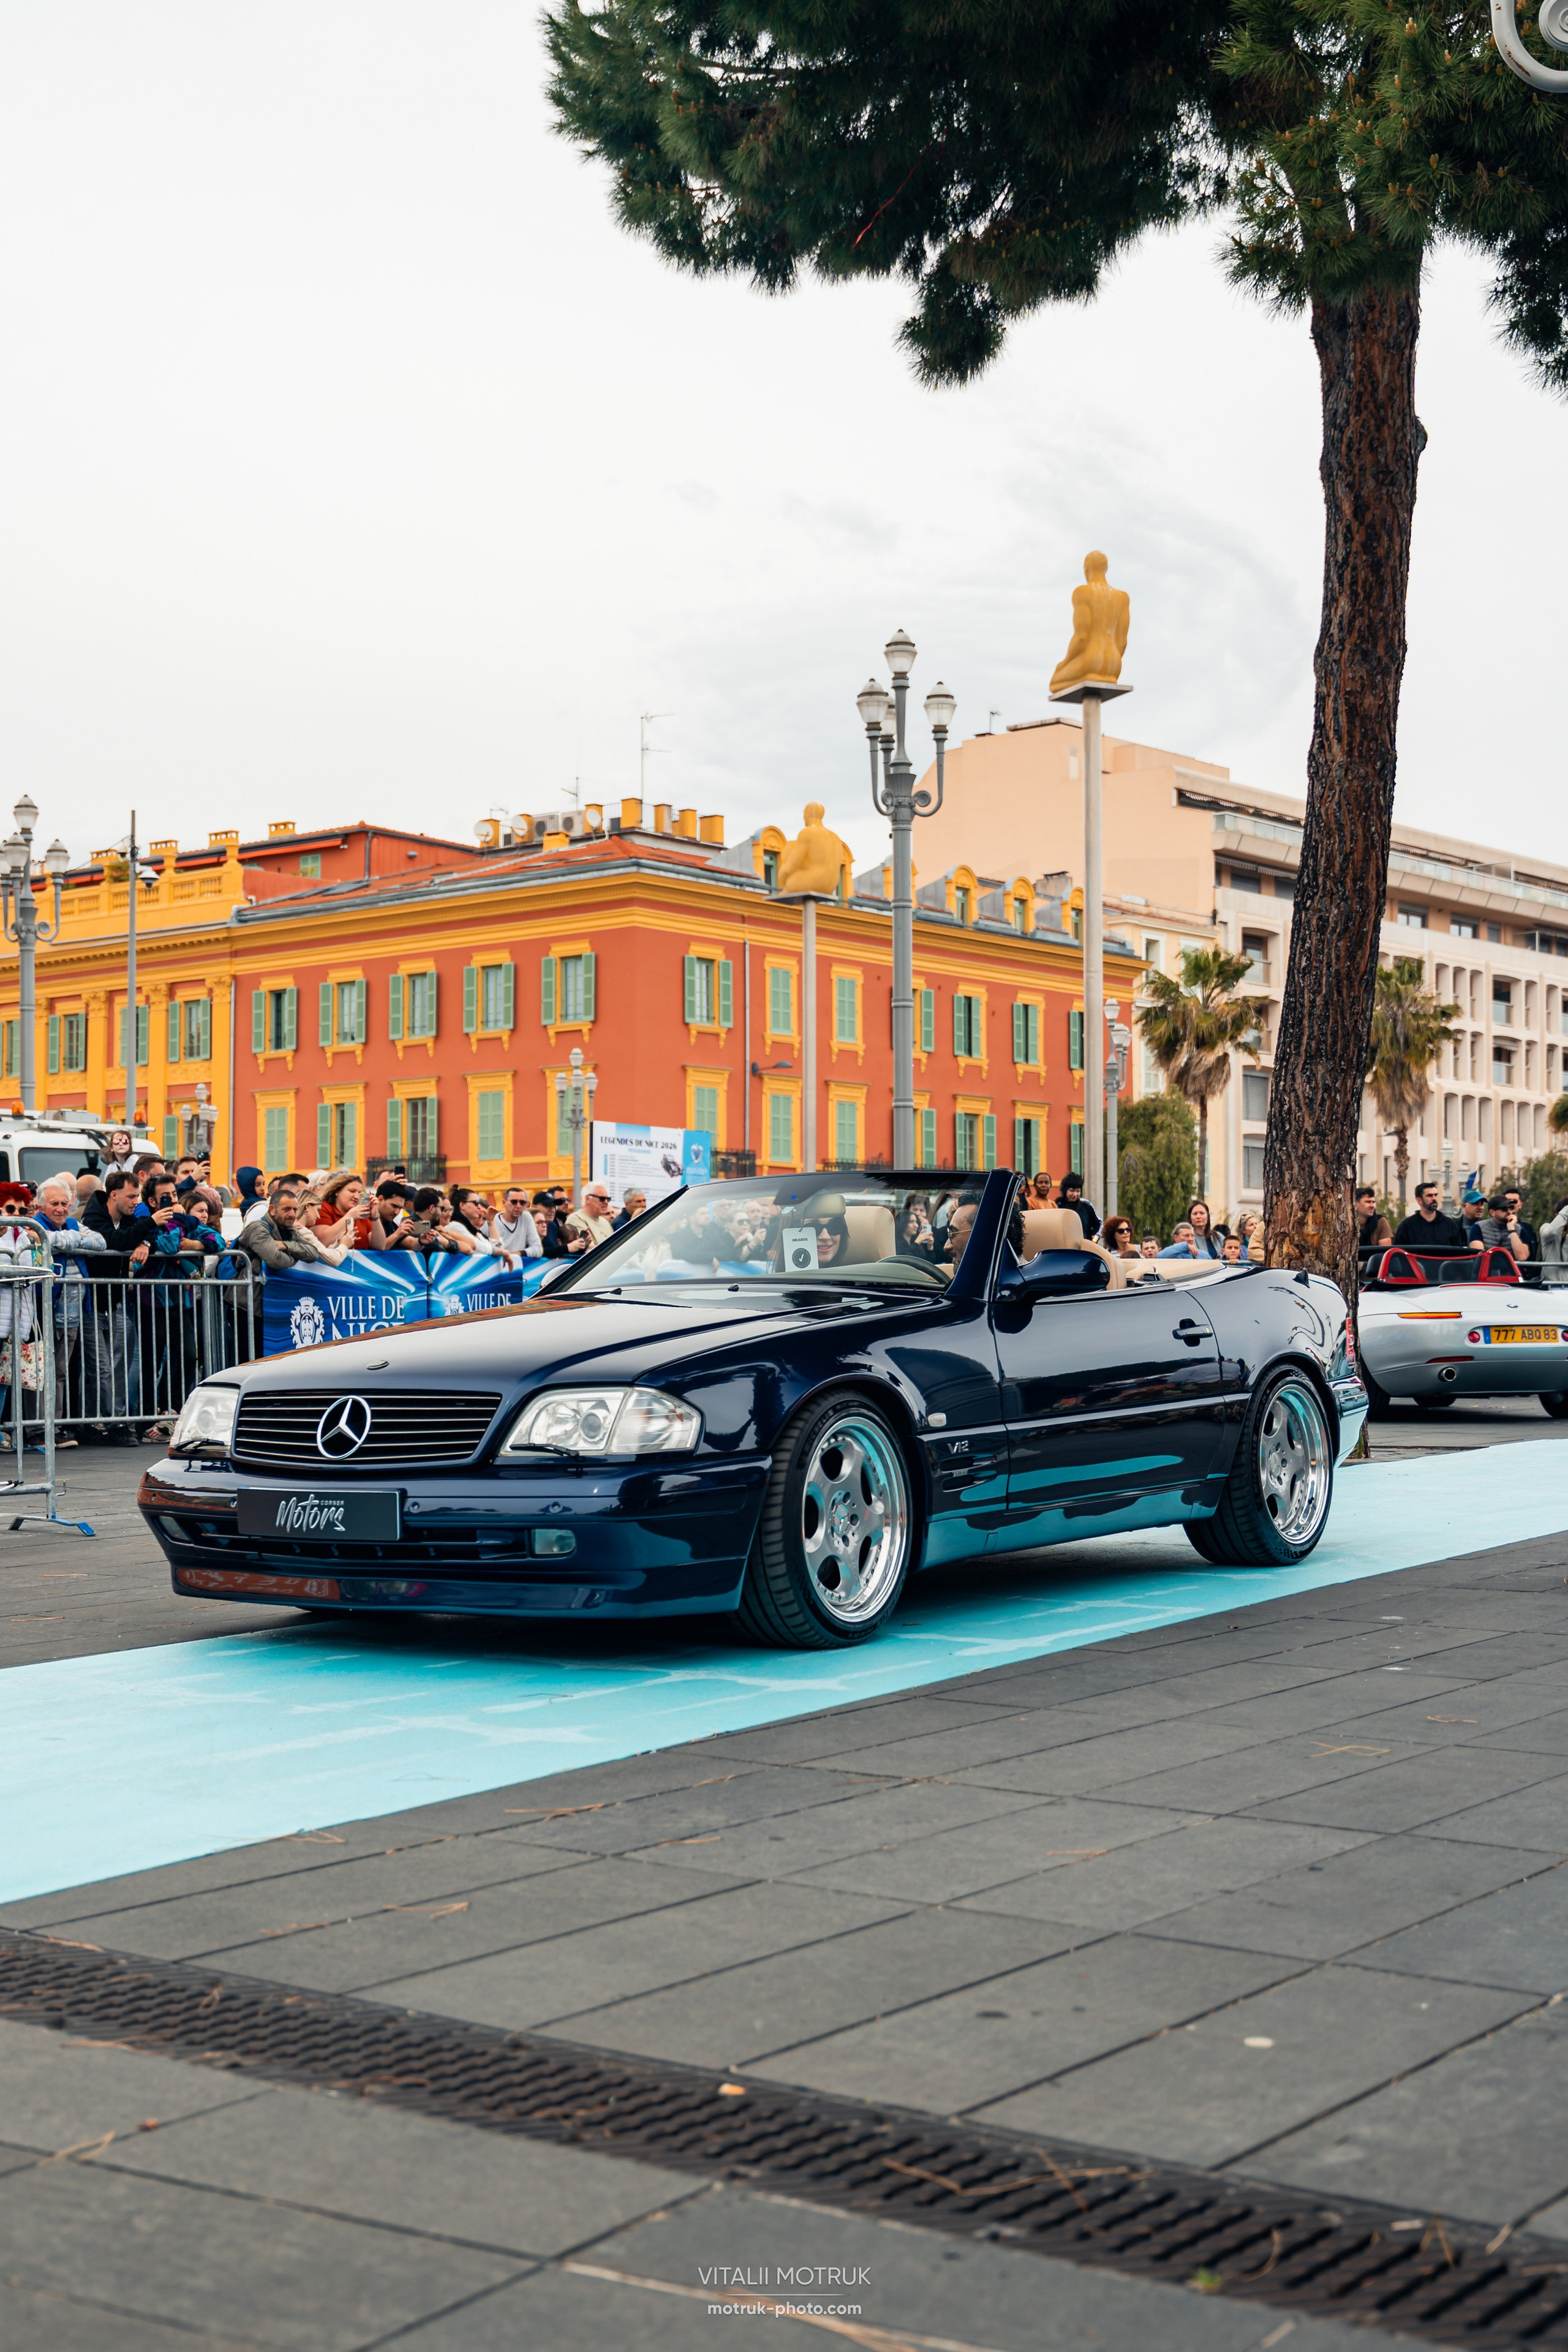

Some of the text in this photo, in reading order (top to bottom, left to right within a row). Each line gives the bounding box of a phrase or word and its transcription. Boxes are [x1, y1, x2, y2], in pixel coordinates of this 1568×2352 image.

[326, 1295, 404, 1320] VILLE DE
[1494, 1329, 1557, 1341] 777 ABQ 83
[947, 1440, 969, 1454] V12
[276, 1494, 345, 1533] Motors
